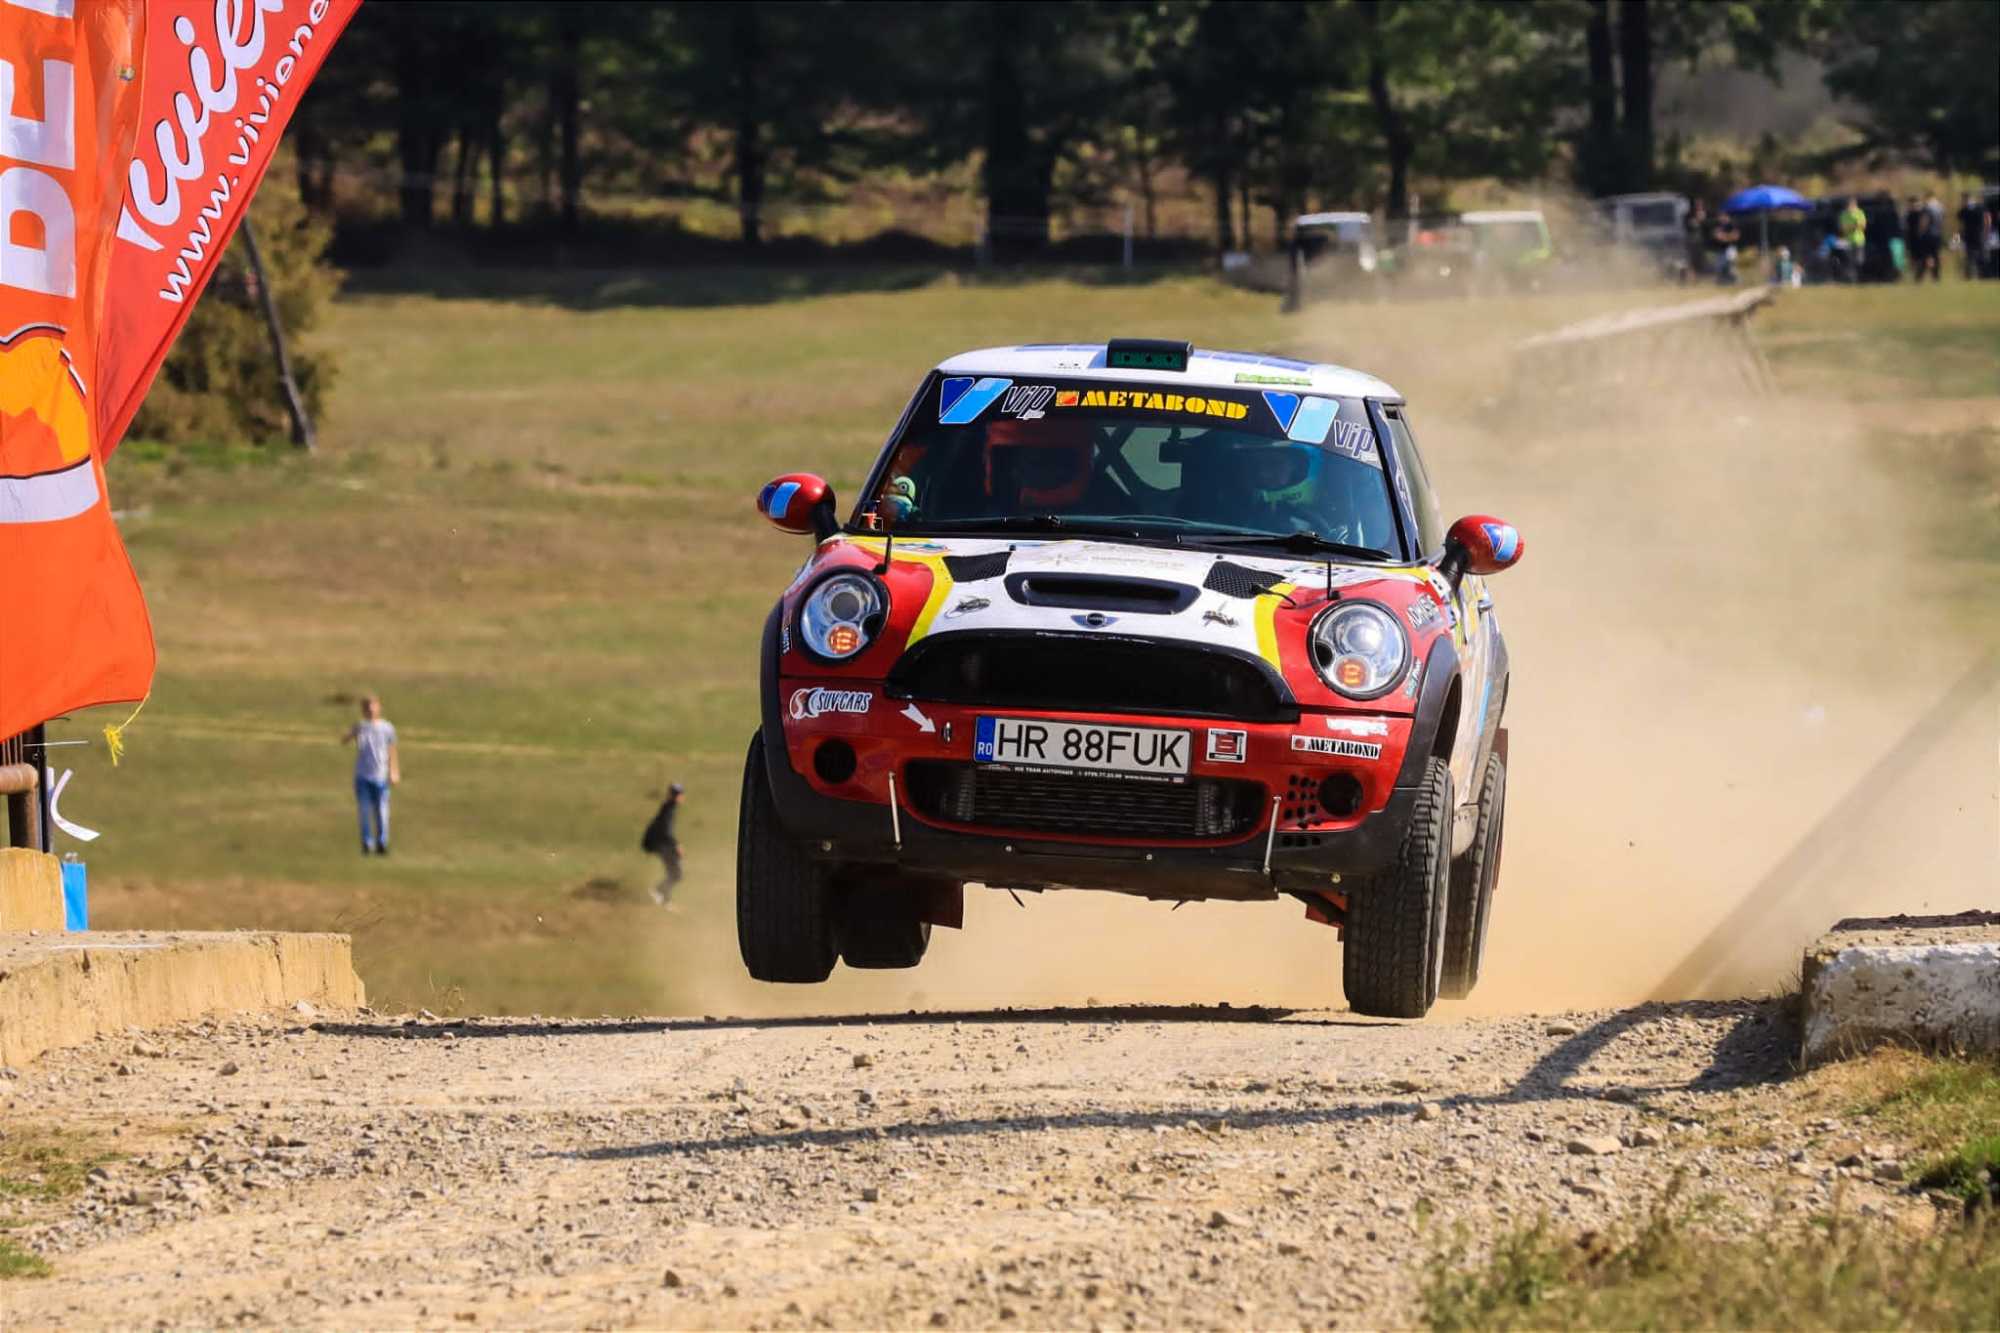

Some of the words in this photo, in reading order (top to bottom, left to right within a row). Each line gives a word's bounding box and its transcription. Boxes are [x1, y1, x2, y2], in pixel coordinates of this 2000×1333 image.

[1081, 391, 1247, 420] METABOND
[977, 741, 993, 756] RO
[998, 722, 1049, 759] HR
[1062, 727, 1185, 768] 88FUK
[1308, 738, 1379, 758] METABOND
